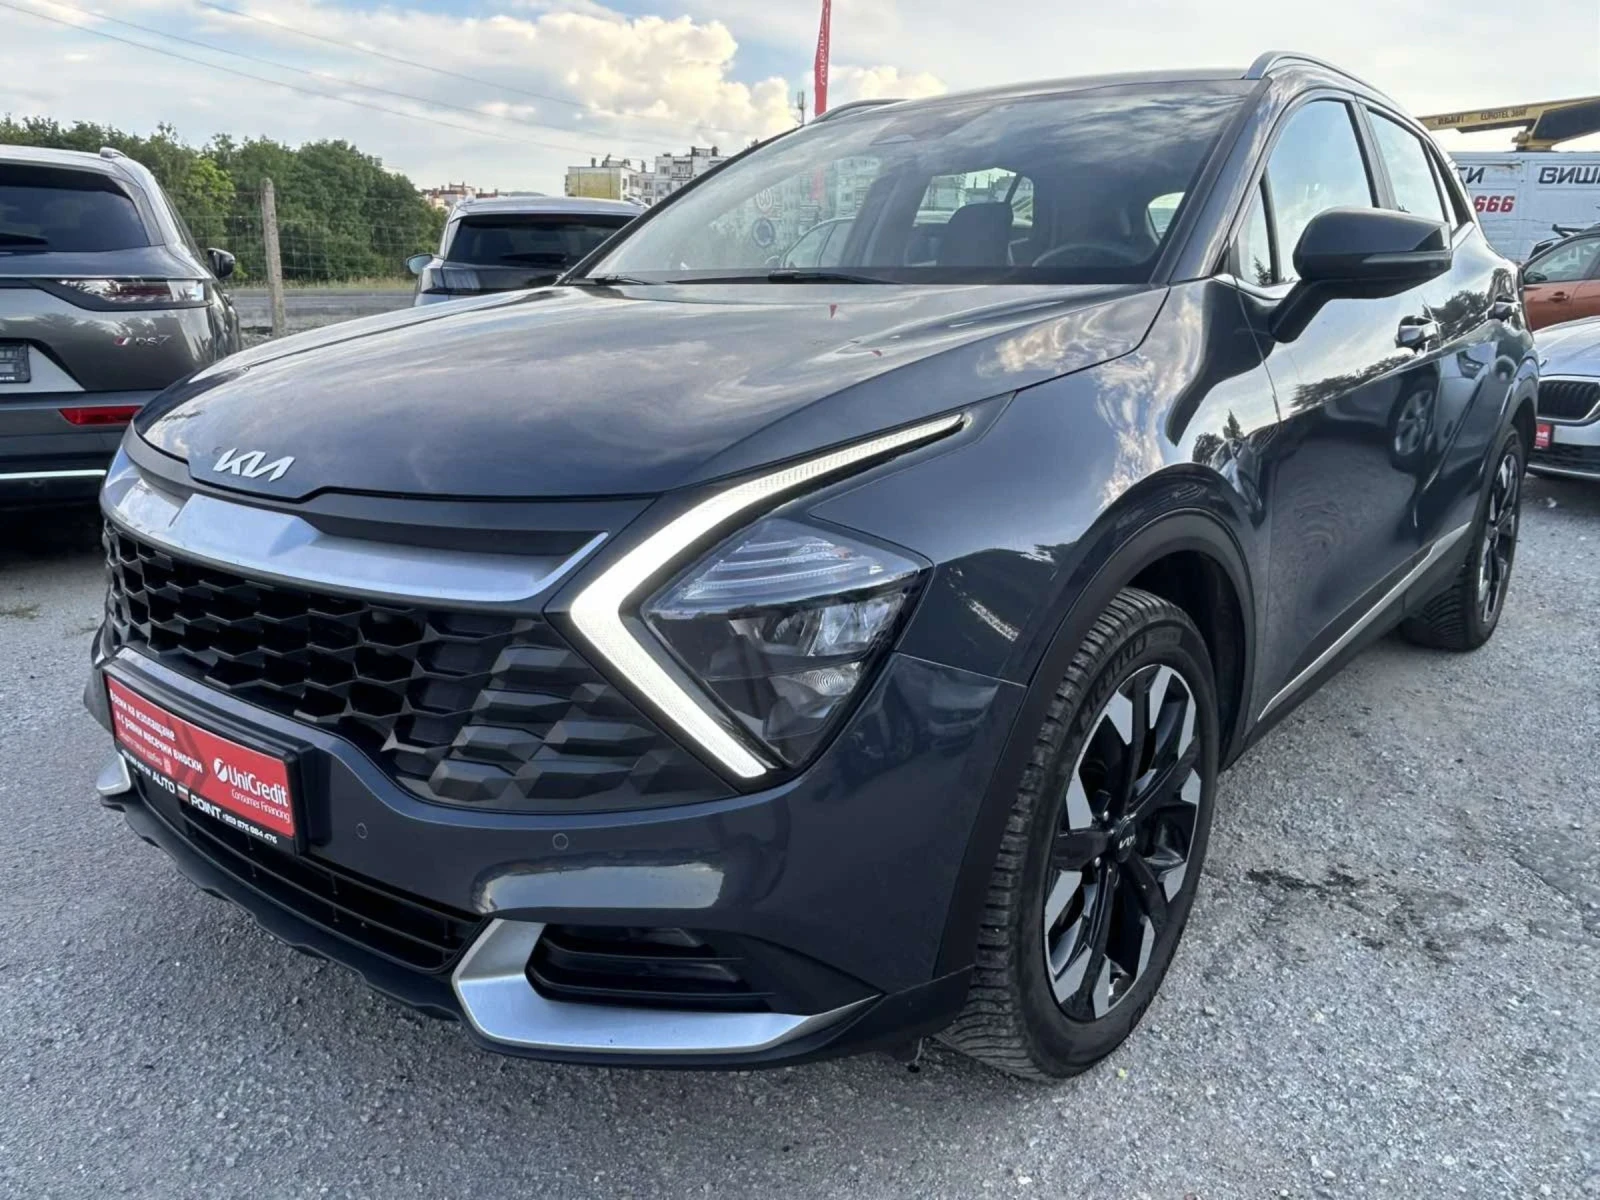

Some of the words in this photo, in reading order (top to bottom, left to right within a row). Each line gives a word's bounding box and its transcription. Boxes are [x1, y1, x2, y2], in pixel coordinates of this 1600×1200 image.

[1538, 166, 1600, 184] ВИШ
[212, 447, 296, 482] KIA
[172, 747, 203, 774] вноски
[152, 769, 176, 794] AUTO
[190, 794, 222, 819] POINT
[228, 764, 289, 808] UniCredit
[231, 788, 261, 809] Consumer
[260, 801, 291, 824] Financing
